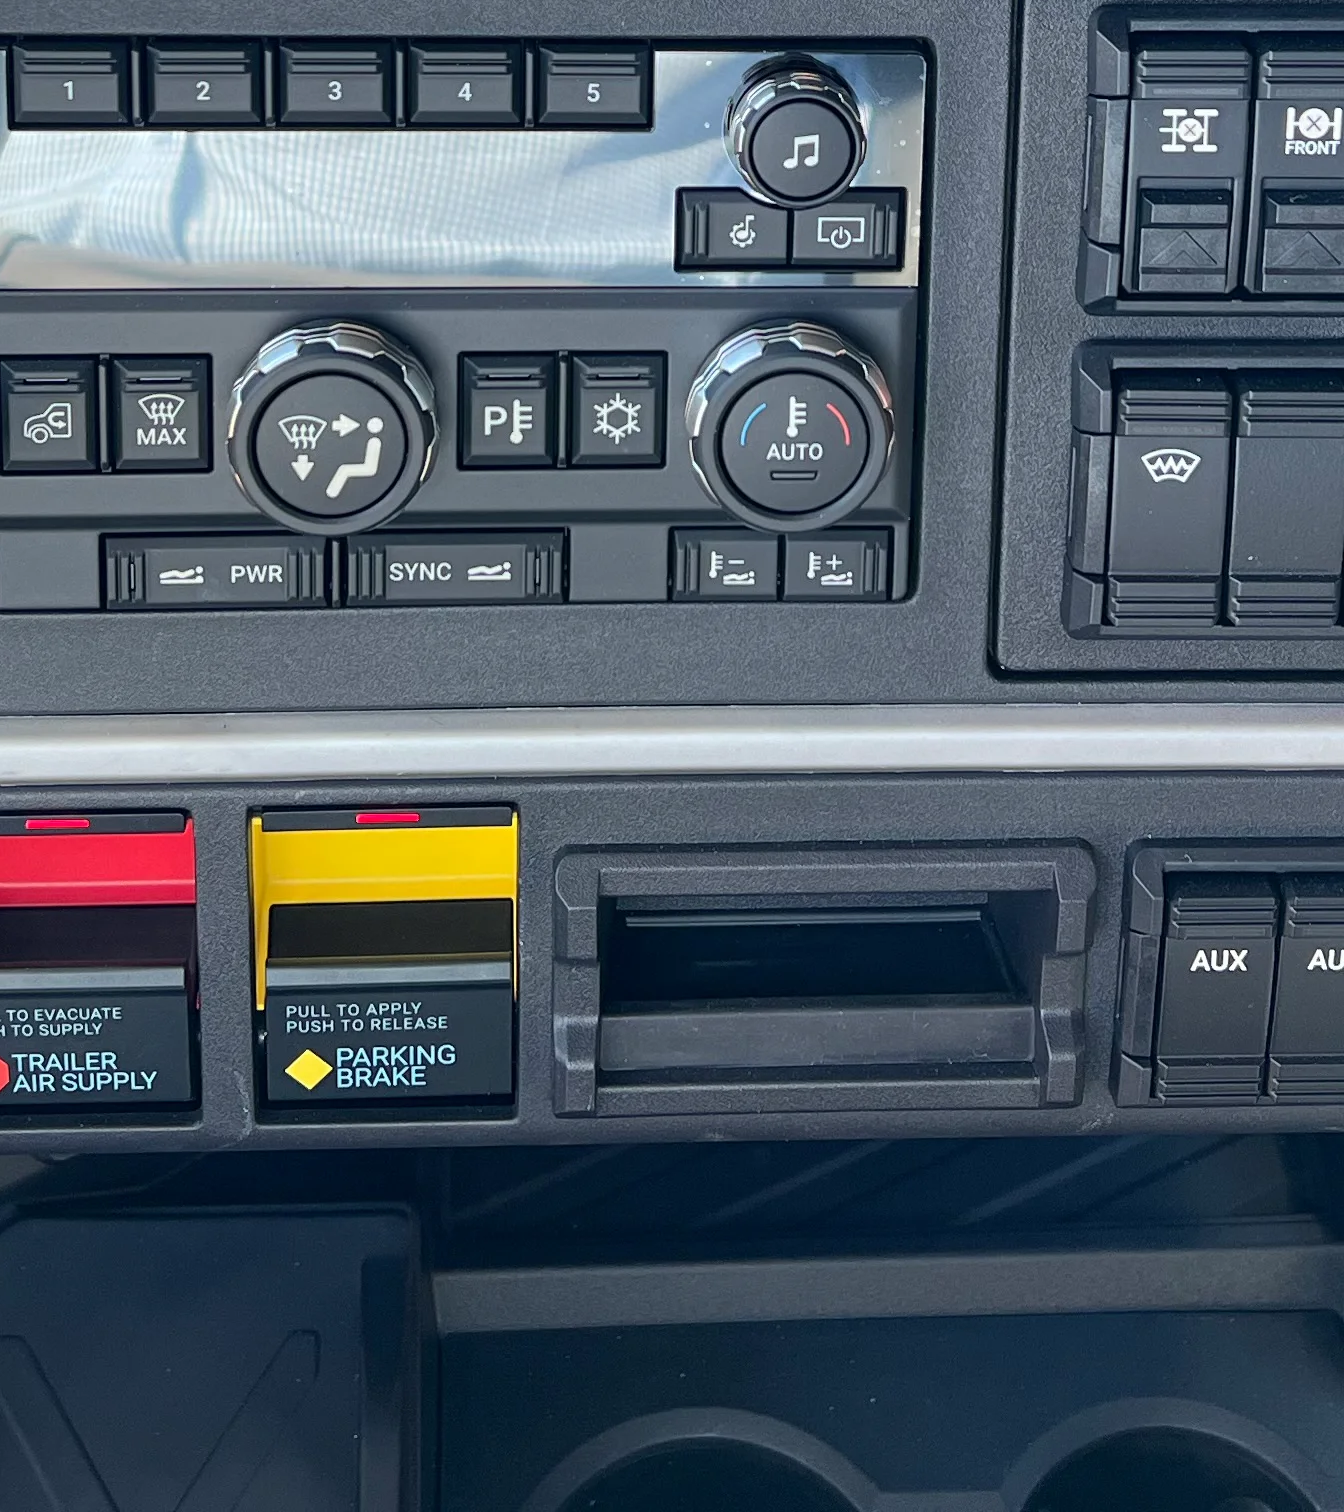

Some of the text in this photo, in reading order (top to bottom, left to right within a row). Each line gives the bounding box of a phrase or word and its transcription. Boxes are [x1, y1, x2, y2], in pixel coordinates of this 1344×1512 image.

[63, 80, 74, 101] 1
[195, 80, 211, 101] 2
[327, 80, 342, 101] 3
[457, 82, 473, 102] 4
[587, 83, 601, 103] 5
[1284, 139, 1342, 156] FRONT
[136, 427, 187, 446] MAX
[766, 442, 823, 461] AUTO
[230, 564, 283, 584] PWR
[389, 562, 452, 582] SYNC
[1189, 949, 1248, 972] AUX
[5, 1009, 29, 1022] TO
[34, 1006, 122, 1022] EVACUATE
[286, 1001, 422, 1018] PULL TO APPLY
[10, 1024, 35, 1037] TO
[38, 1022, 103, 1037] SUPPLY
[286, 1015, 448, 1034] PUSH TO RELEASE
[11, 1051, 118, 1073] TRAILER
[336, 1044, 456, 1068] PARKING
[13, 1070, 158, 1093] AIR SUPPLY
[336, 1065, 427, 1089] BRAKE
